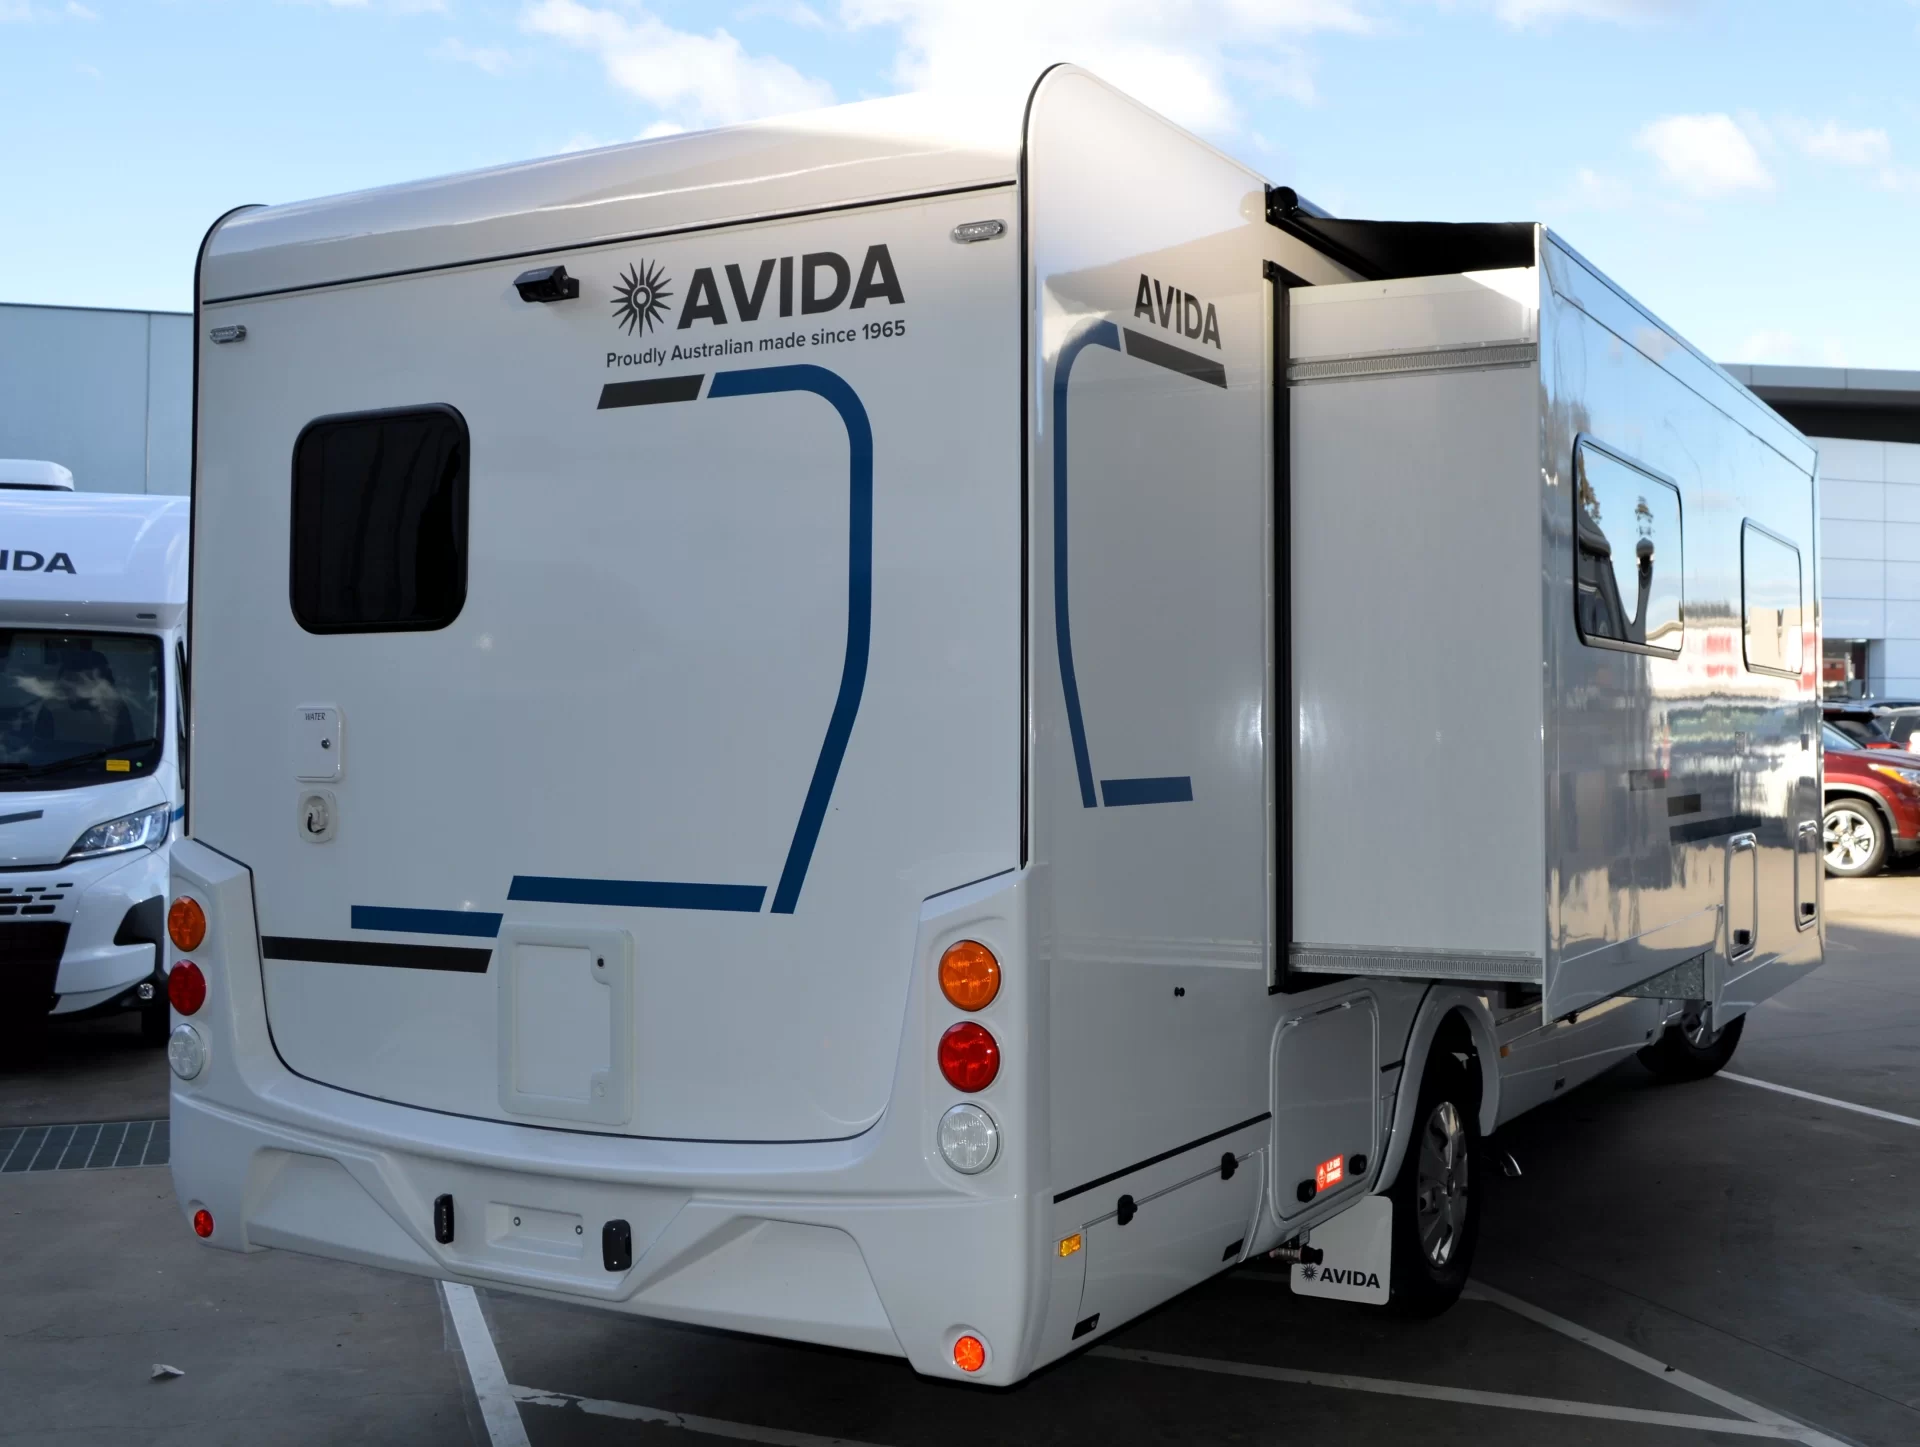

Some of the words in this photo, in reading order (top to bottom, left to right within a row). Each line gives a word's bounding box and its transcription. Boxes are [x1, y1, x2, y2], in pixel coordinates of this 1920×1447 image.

[677, 244, 906, 330] AVIDA
[1134, 273, 1222, 350] AVIDA
[606, 347, 667, 368] Proudly
[671, 338, 754, 361] Australian
[759, 331, 806, 352] made
[811, 328, 857, 346] since
[861, 319, 906, 340] 1965
[0, 549, 77, 575] IDA
[305, 712, 326, 721] WATER
[1320, 1267, 1381, 1289] AVIDA
